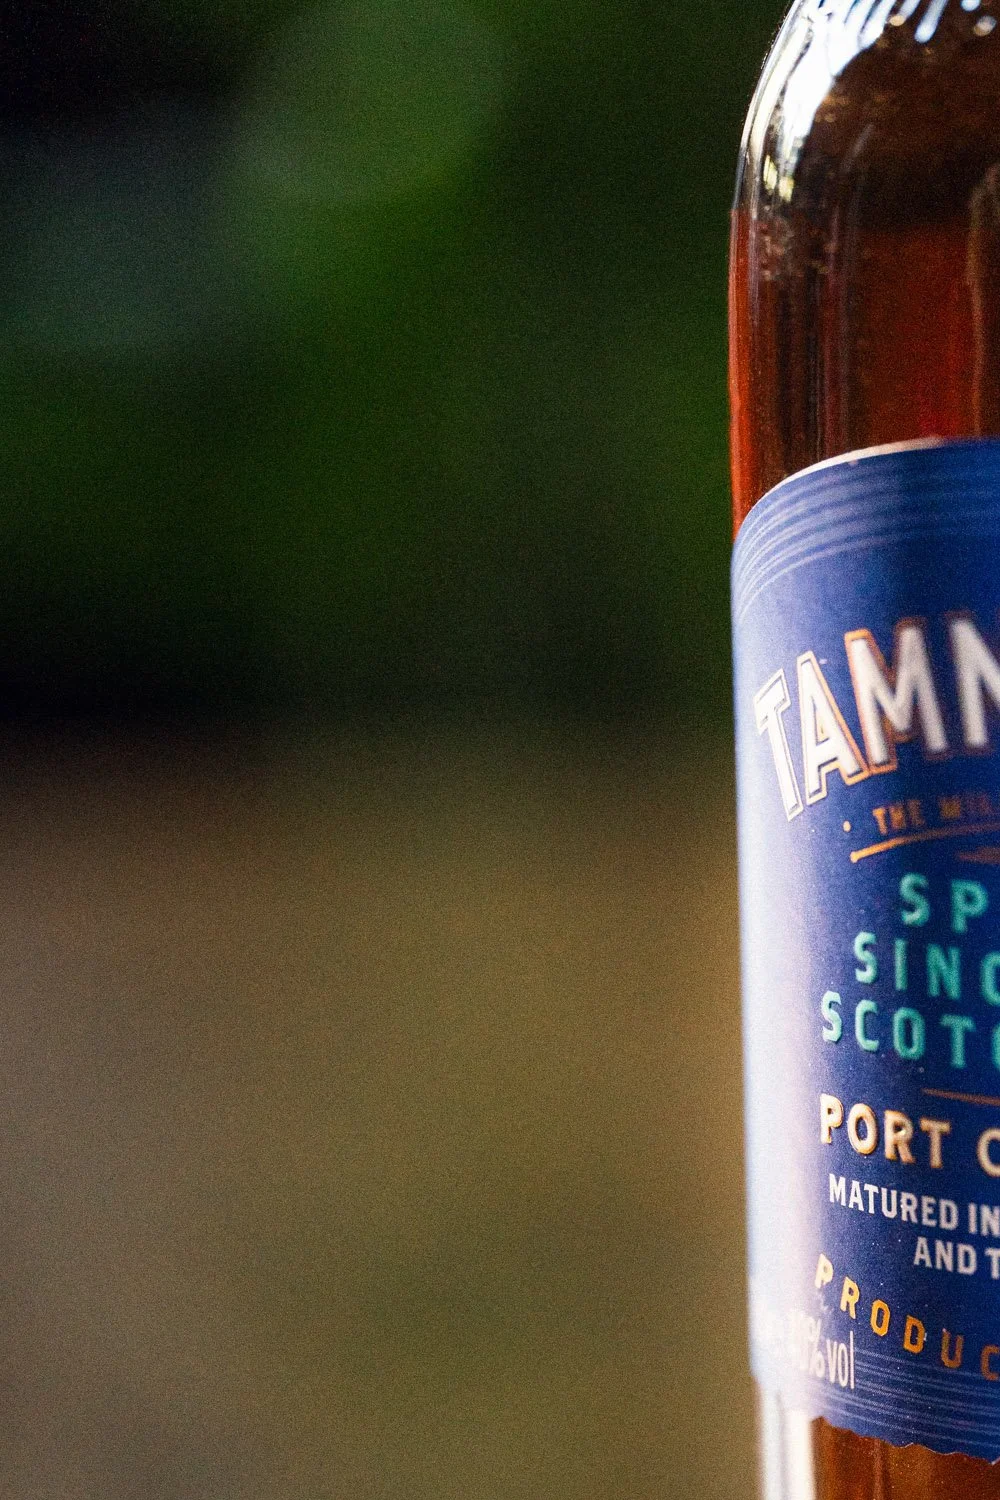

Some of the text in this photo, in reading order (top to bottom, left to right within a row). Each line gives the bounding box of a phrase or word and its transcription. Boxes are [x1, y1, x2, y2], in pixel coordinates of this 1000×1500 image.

[819, 1092, 952, 1169] PORT
[828, 1172, 959, 1230] MATURED
[913, 1236, 977, 1276] AND
